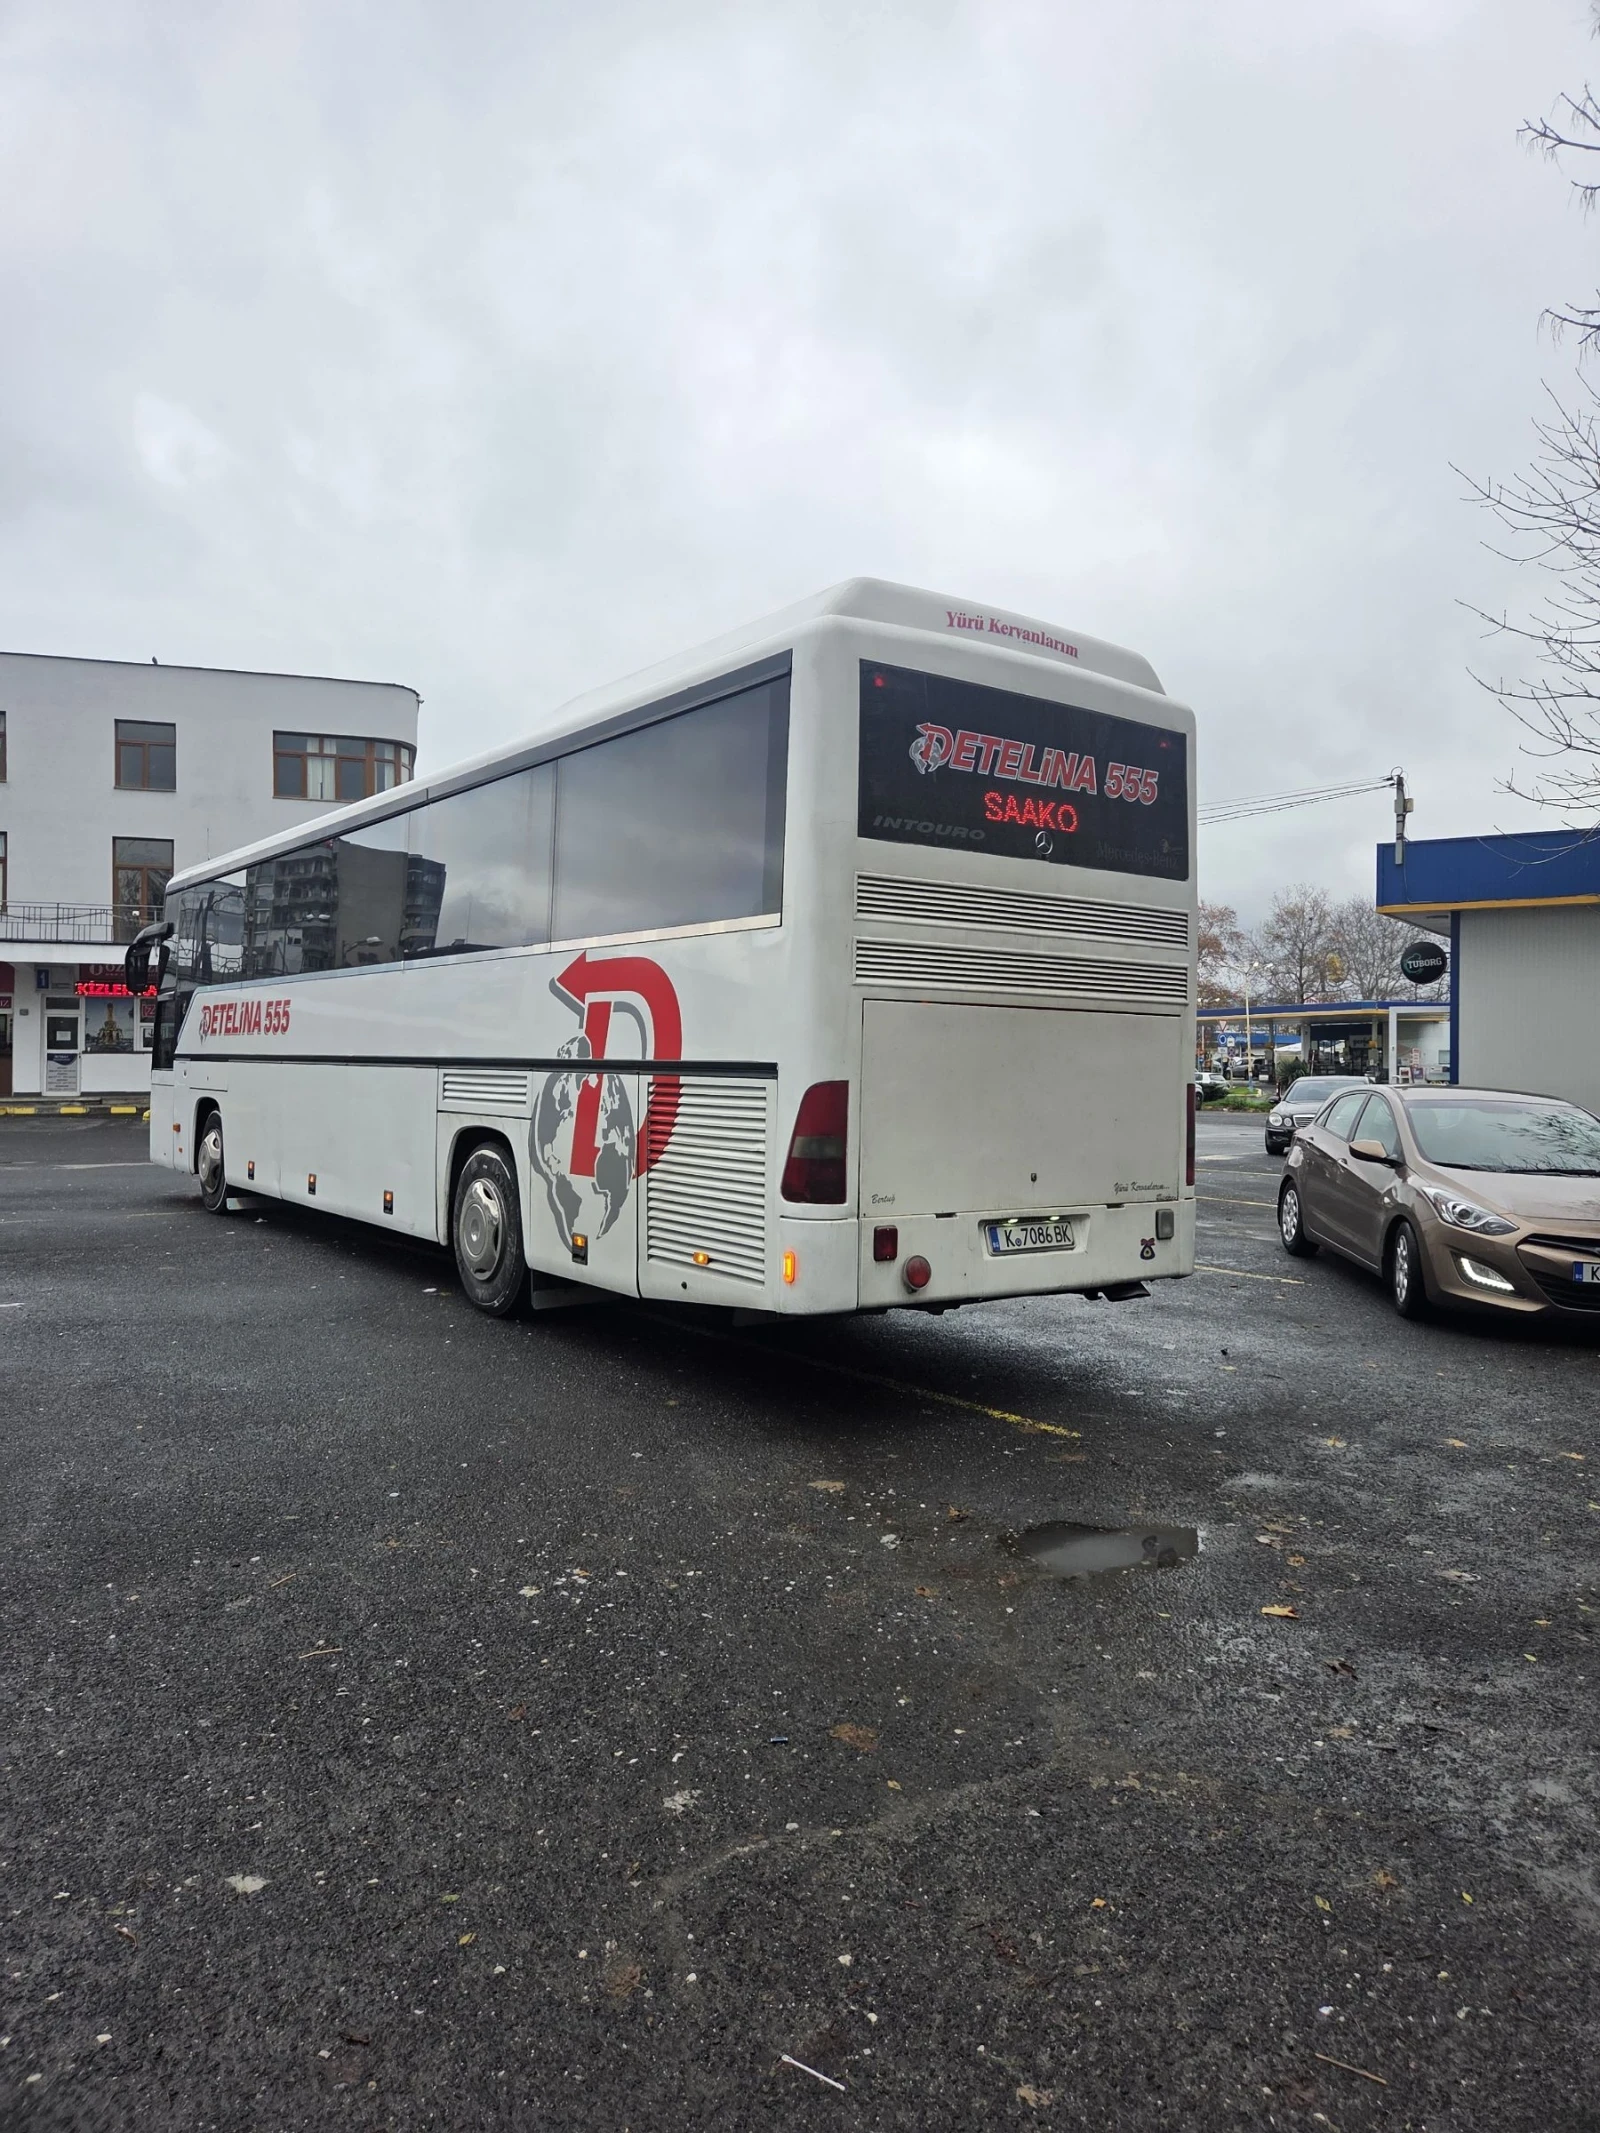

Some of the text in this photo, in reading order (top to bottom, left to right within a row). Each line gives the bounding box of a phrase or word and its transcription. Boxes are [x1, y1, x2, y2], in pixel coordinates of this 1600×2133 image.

[946, 611, 1079, 659] Yürü Kervanlarım
[1104, 762, 1159, 805] 555
[873, 815, 986, 840] INTOURO
[984, 791, 1079, 833] SAAKO
[1407, 957, 1442, 969] TUBORG
[40, 972, 46, 987] 1
[264, 999, 291, 1036] 555
[1004, 1224, 1071, 1248] K 7086 BK
